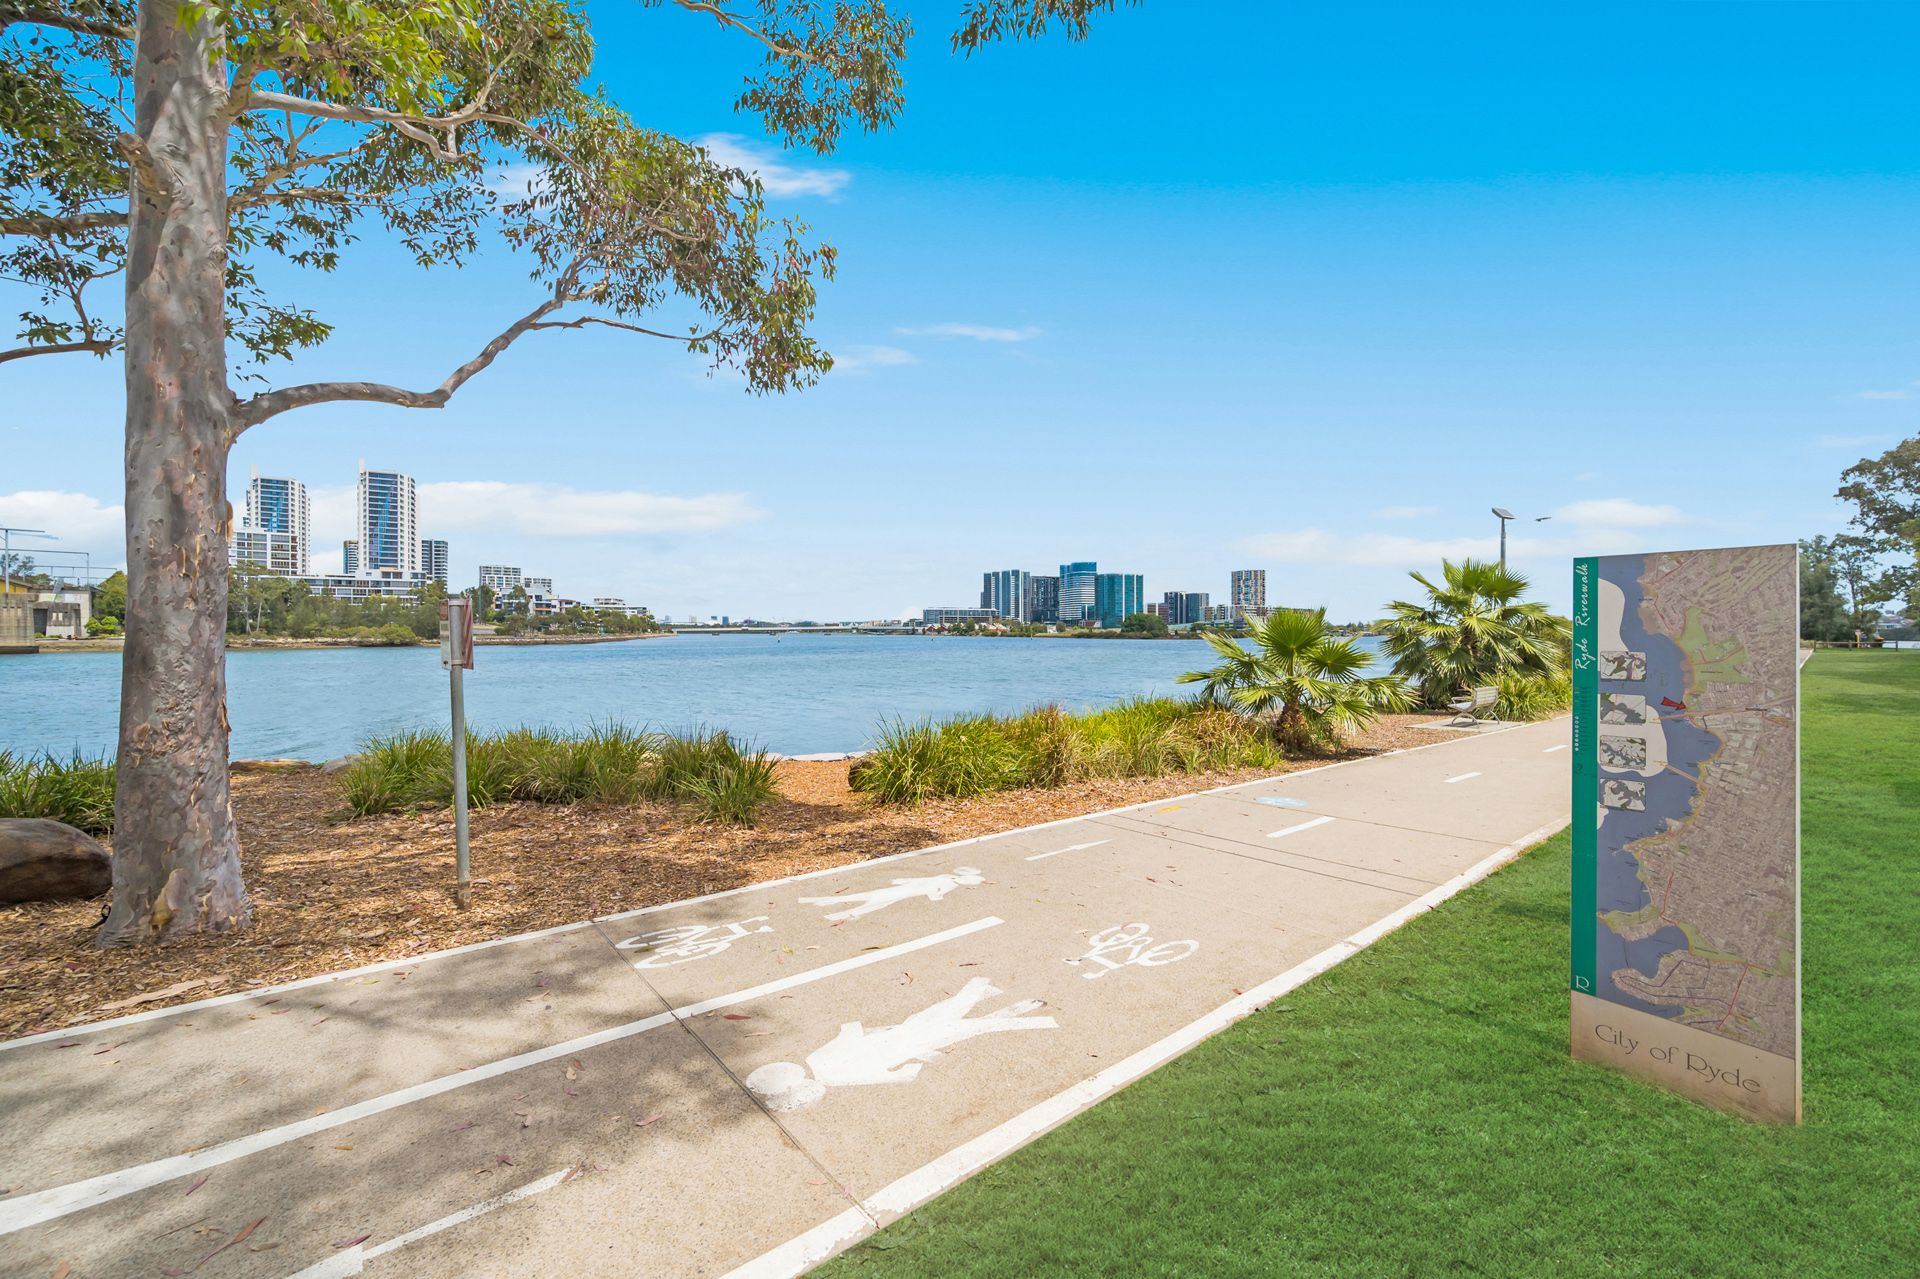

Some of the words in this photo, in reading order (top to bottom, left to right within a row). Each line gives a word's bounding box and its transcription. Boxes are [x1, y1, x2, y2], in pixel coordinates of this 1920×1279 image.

[1575, 563, 1590, 627] Riverwalk
[1575, 638, 1596, 670] Ryde
[1595, 1024, 1639, 1055] City
[1649, 1046, 1679, 1063] of
[1686, 1053, 1761, 1093] Ryde
